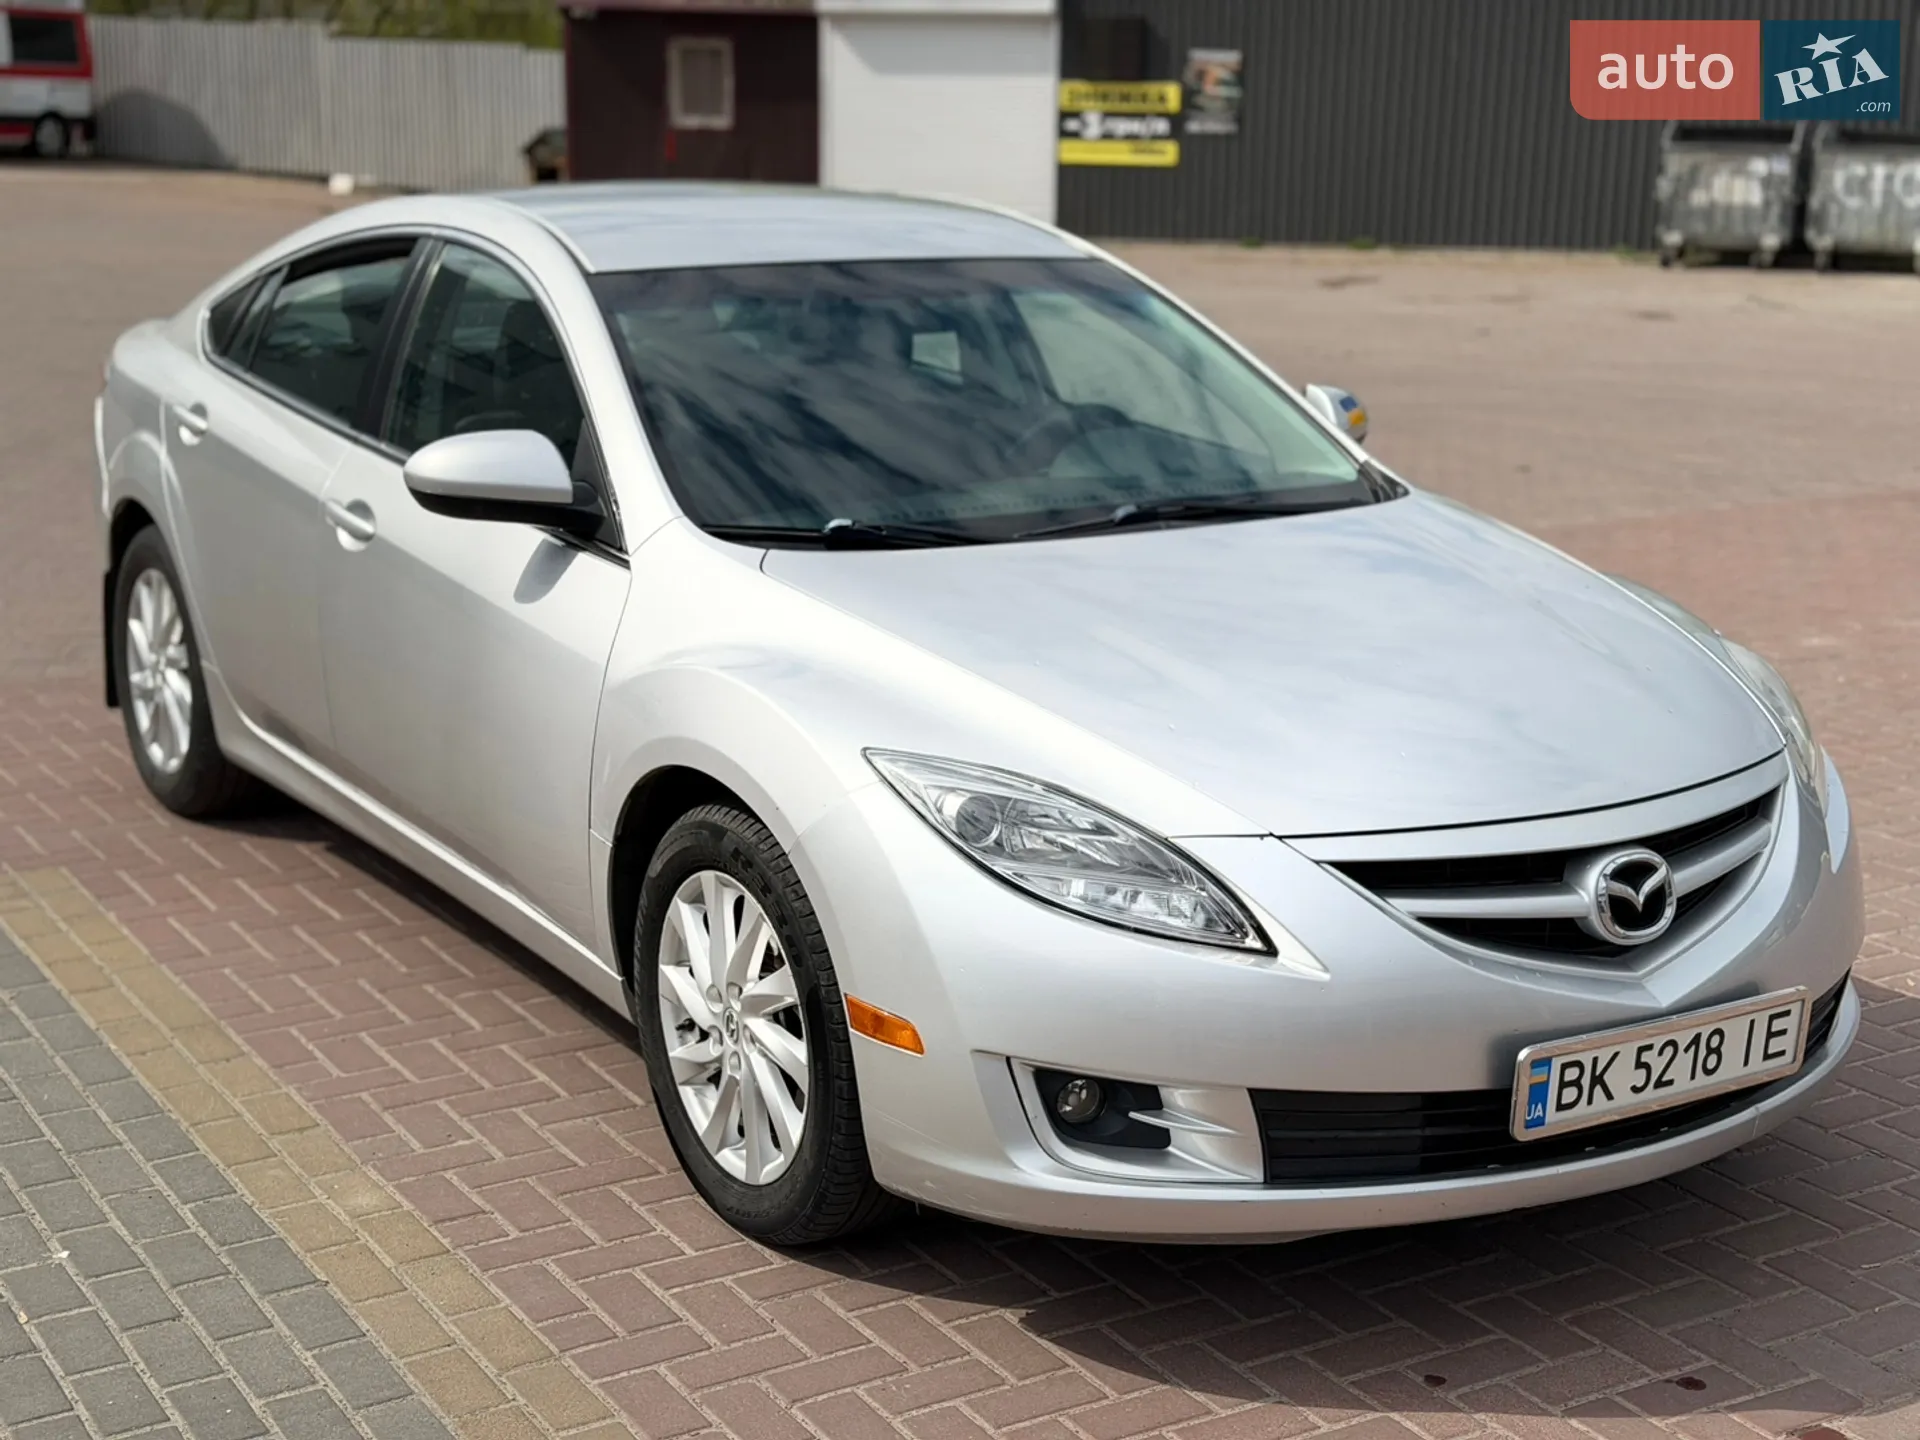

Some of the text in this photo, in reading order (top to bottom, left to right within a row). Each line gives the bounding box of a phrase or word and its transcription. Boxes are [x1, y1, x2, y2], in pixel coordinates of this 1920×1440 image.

[1555, 1009, 1792, 1112] BK 5218 IE
[1525, 1102, 1544, 1120] UA
